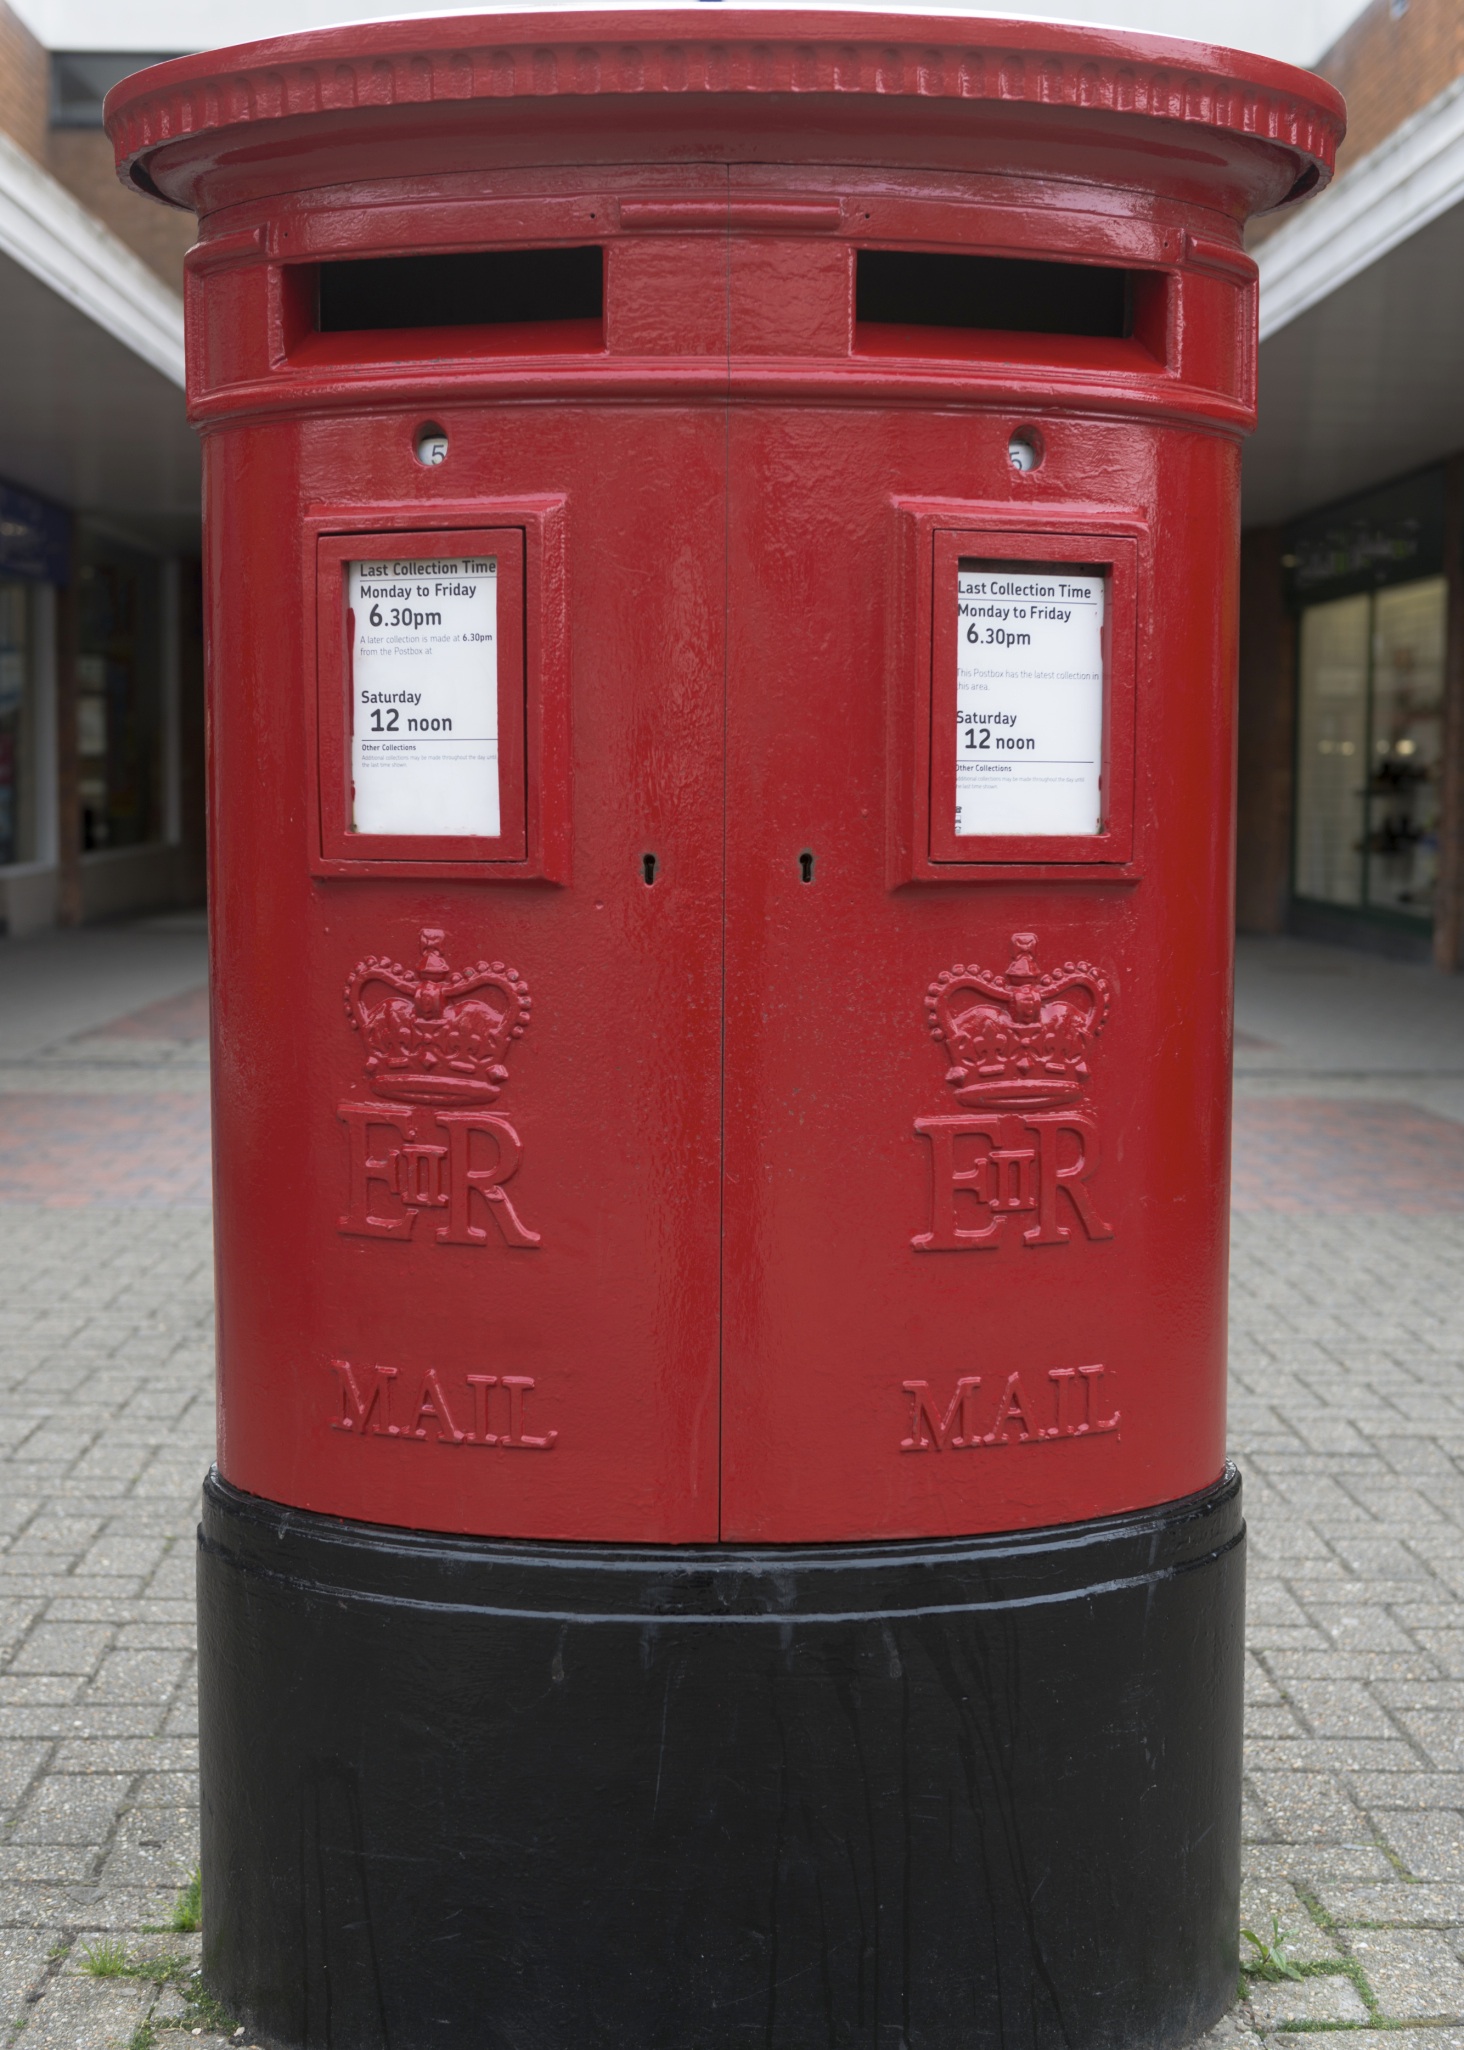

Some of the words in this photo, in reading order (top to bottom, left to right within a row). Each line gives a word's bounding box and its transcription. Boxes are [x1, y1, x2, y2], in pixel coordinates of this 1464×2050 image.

[432, 444, 445, 464] 5
[360, 563, 388, 576] Last
[393, 561, 458, 576] Collection
[462, 560, 496, 573] Time
[360, 584, 412, 600] Monday
[416, 584, 430, 597] to
[435, 583, 476, 598] Friday
[958, 580, 986, 594] Last
[990, 582, 1054, 596] Collection
[1059, 584, 1091, 598] Time
[370, 604, 442, 630] 6.30pm
[958, 604, 1010, 620] Monday
[1014, 606, 1026, 618] to
[1030, 606, 1071, 622] Friday
[360, 636, 366, 644] A
[367, 635, 384, 644] later
[386, 634, 420, 644] collection
[422, 634, 428, 643] is
[430, 634, 450, 642] made
[462, 633, 492, 643] 6.30pm
[967, 622, 1030, 648] 6.30pm
[360, 648, 378, 656] from
[380, 647, 392, 656] the
[394, 647, 422, 656] Postbox
[957, 668, 972, 677] This
[974, 668, 1004, 678] Postbox
[1006, 669, 1018, 678] has
[1021, 670, 1032, 678] the
[1034, 670, 1054, 679] latest
[1056, 671, 1090, 680] collection
[1092, 672, 1099, 680] in
[957, 682, 969, 690] his
[362, 690, 422, 706] Saturday
[370, 708, 400, 732] 12
[408, 718, 452, 732] noon
[956, 711, 1017, 728] Saturday
[965, 728, 990, 749] 12
[996, 738, 1034, 750] noon
[331, 1360, 558, 1449] MAIL
[900, 1364, 1122, 1451] MAIL
